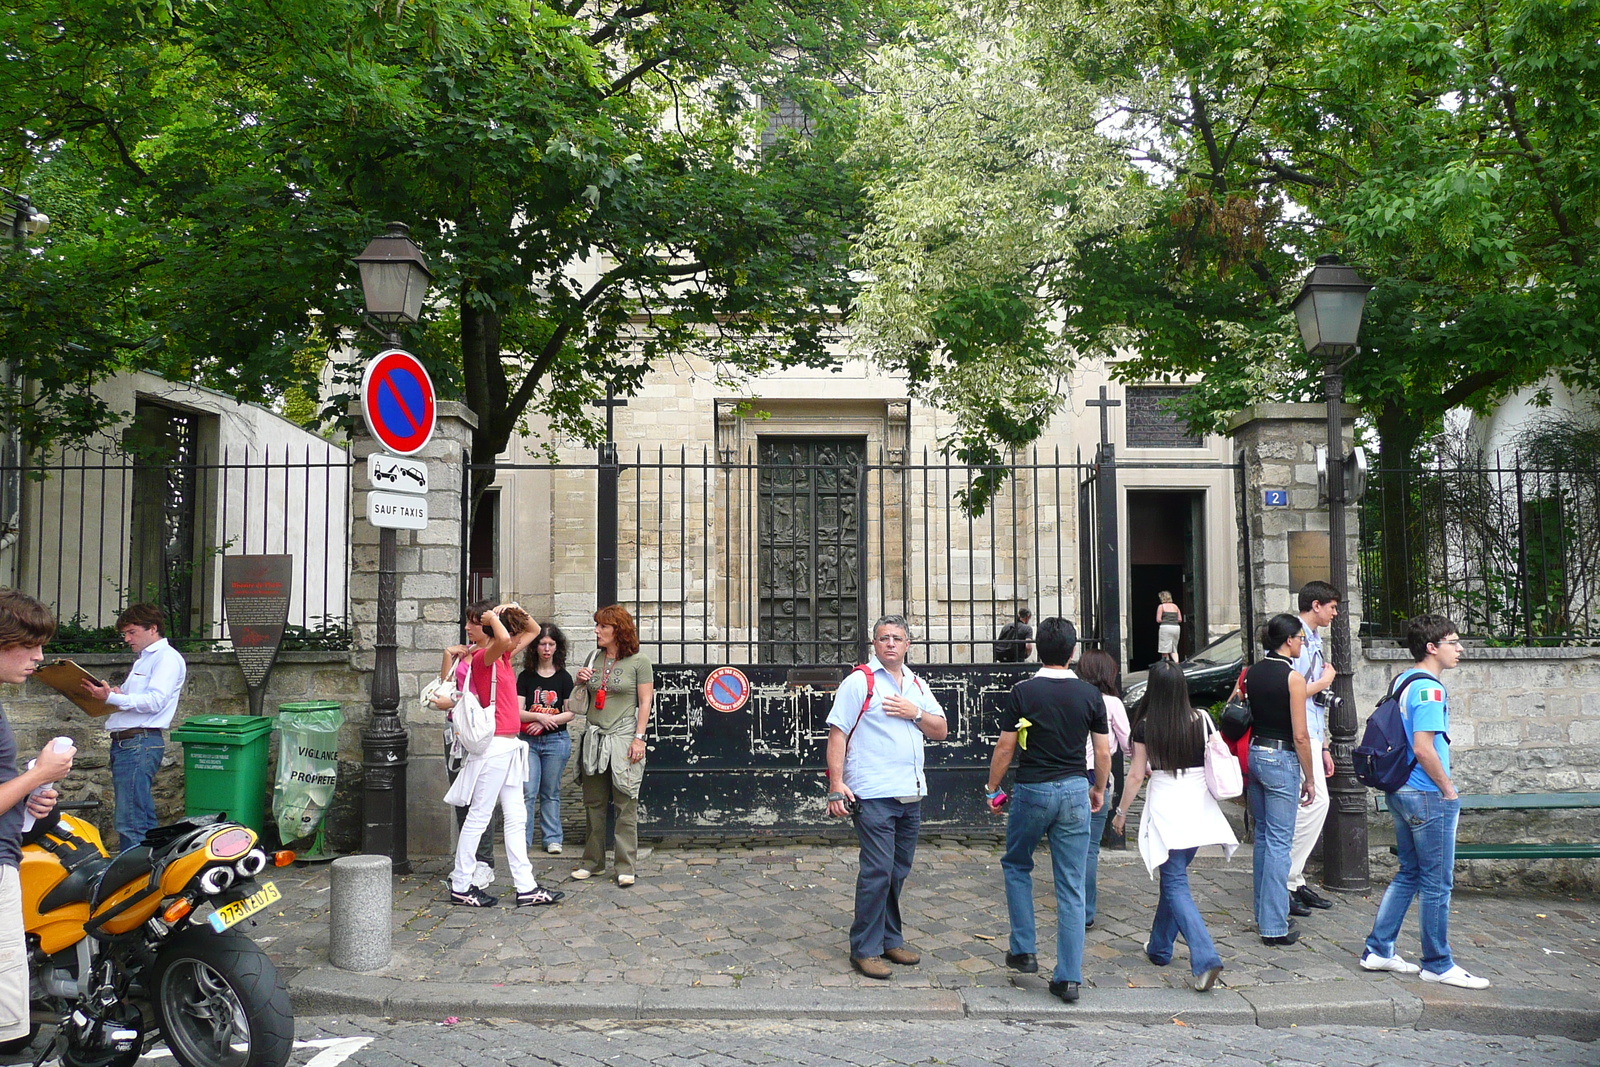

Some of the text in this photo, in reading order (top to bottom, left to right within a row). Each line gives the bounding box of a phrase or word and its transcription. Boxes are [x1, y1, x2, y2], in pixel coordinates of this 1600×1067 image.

[1272, 492, 1280, 504] 2
[374, 504, 424, 518] SAUF TAXIS
[1371, 648, 1413, 658] ESPA
[533, 690, 541, 704] I
